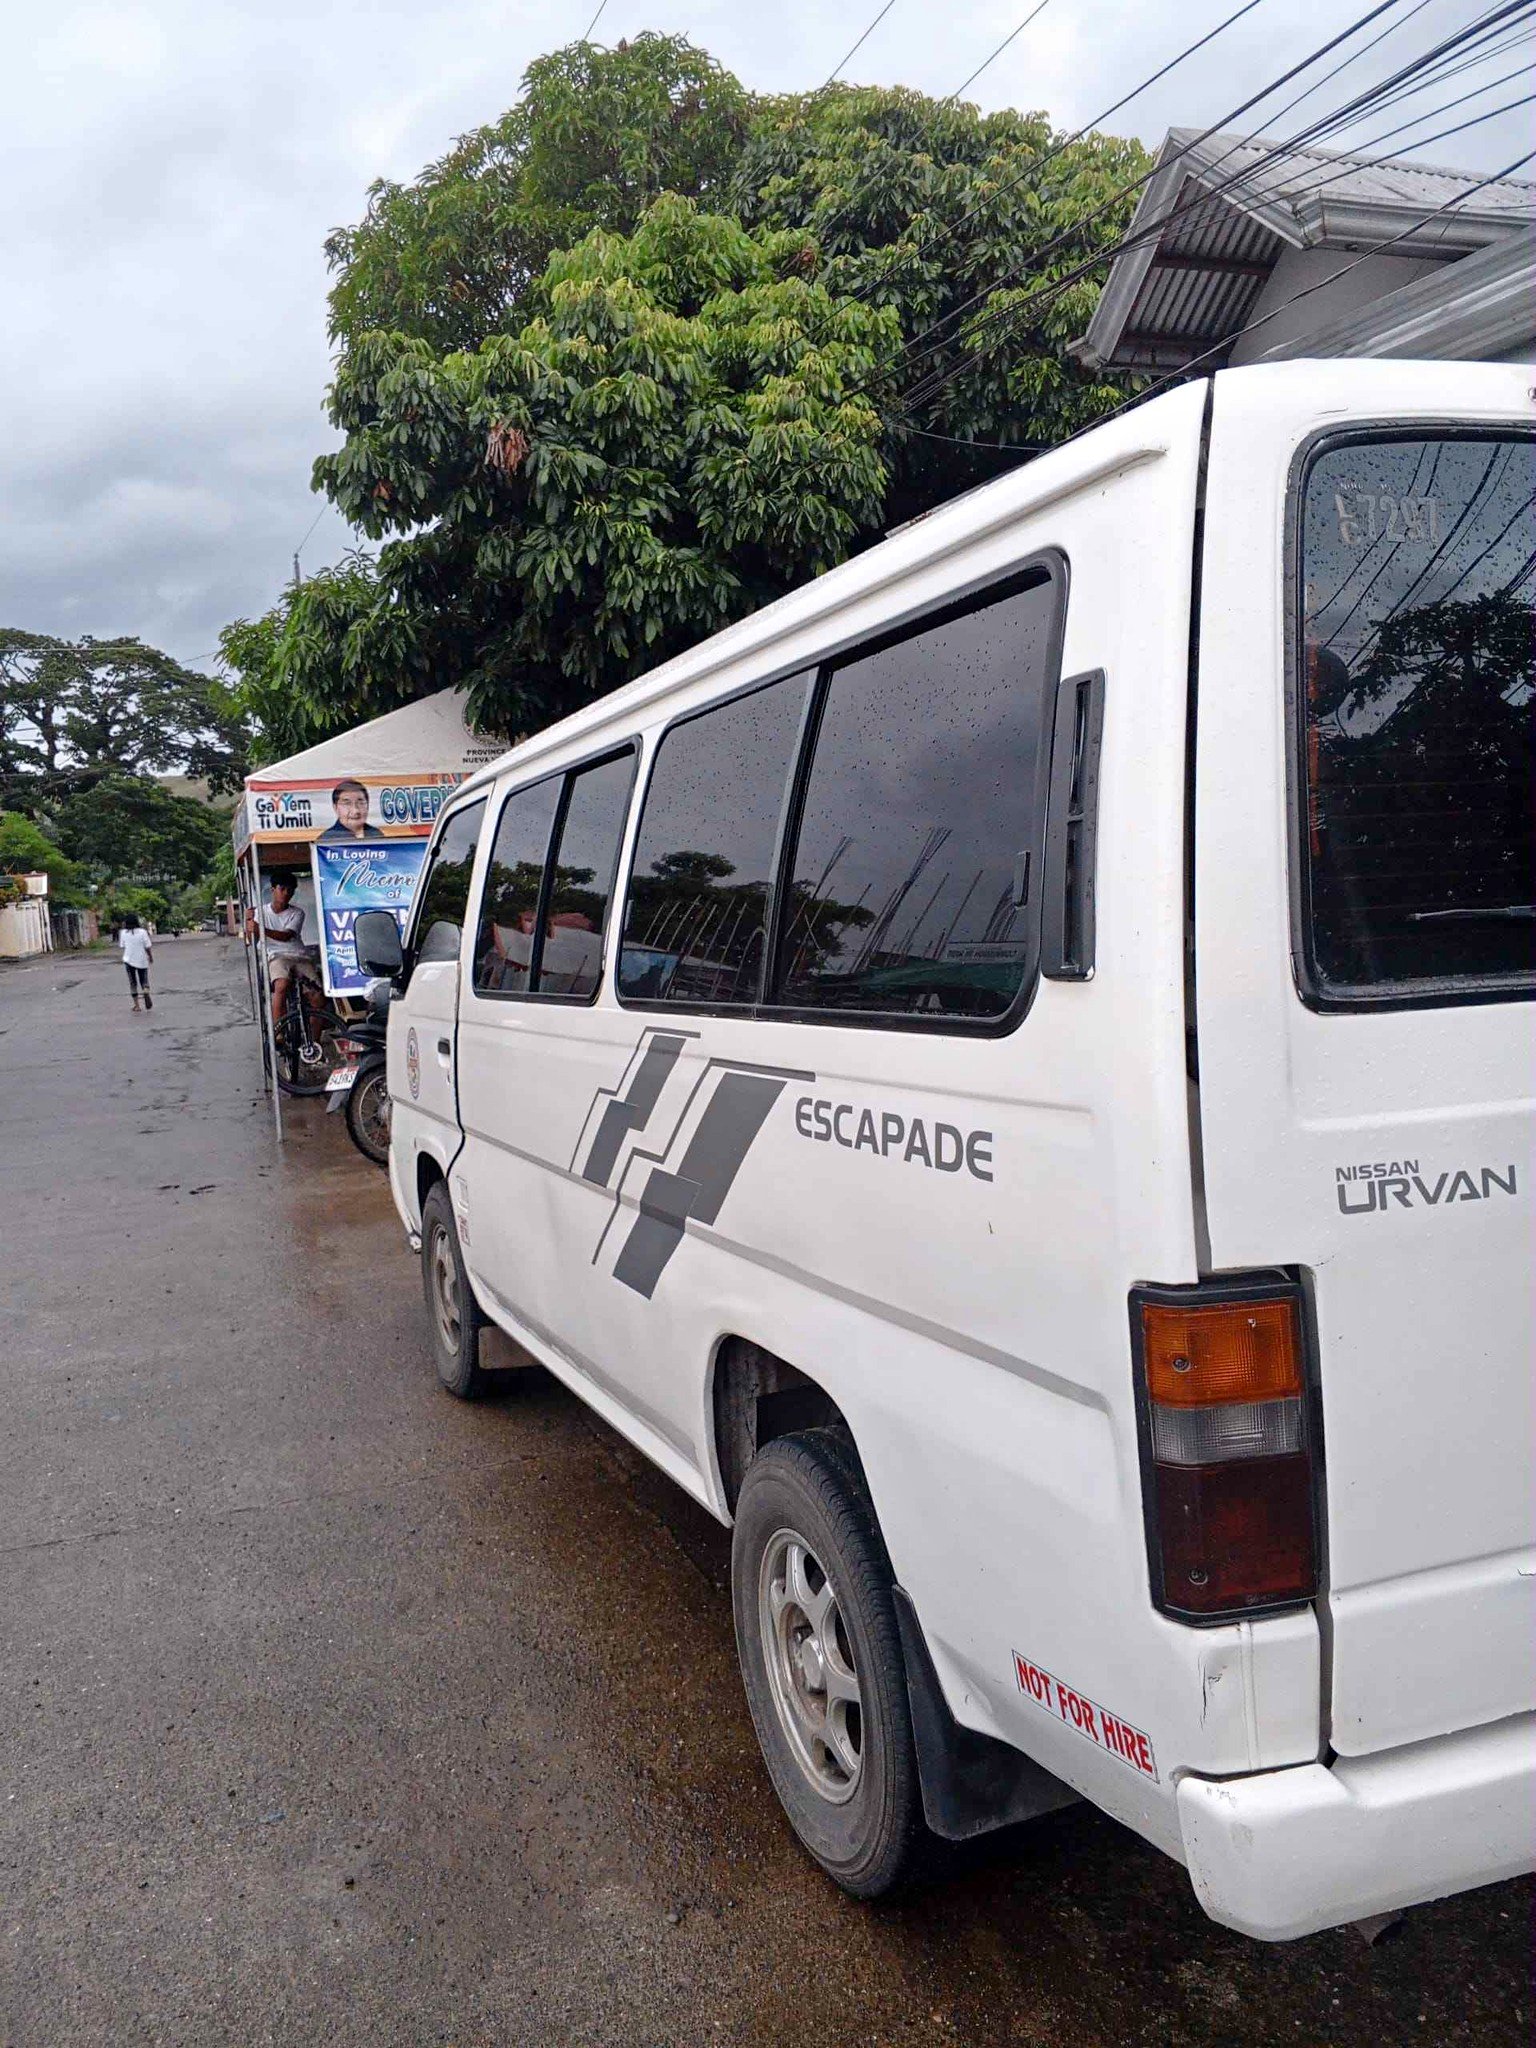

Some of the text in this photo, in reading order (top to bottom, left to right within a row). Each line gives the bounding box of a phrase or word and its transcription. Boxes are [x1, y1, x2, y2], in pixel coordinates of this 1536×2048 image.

[257, 812, 312, 829] Ti Umili
[326, 848, 386, 860] In Loving
[387, 889, 402, 898] of
[795, 1097, 994, 1182] ESCAPADE
[1335, 1159, 1420, 1183] NISSAN
[1336, 1165, 1518, 1215] URVAN
[1015, 1655, 1153, 1773] NOT FOR HIRE
